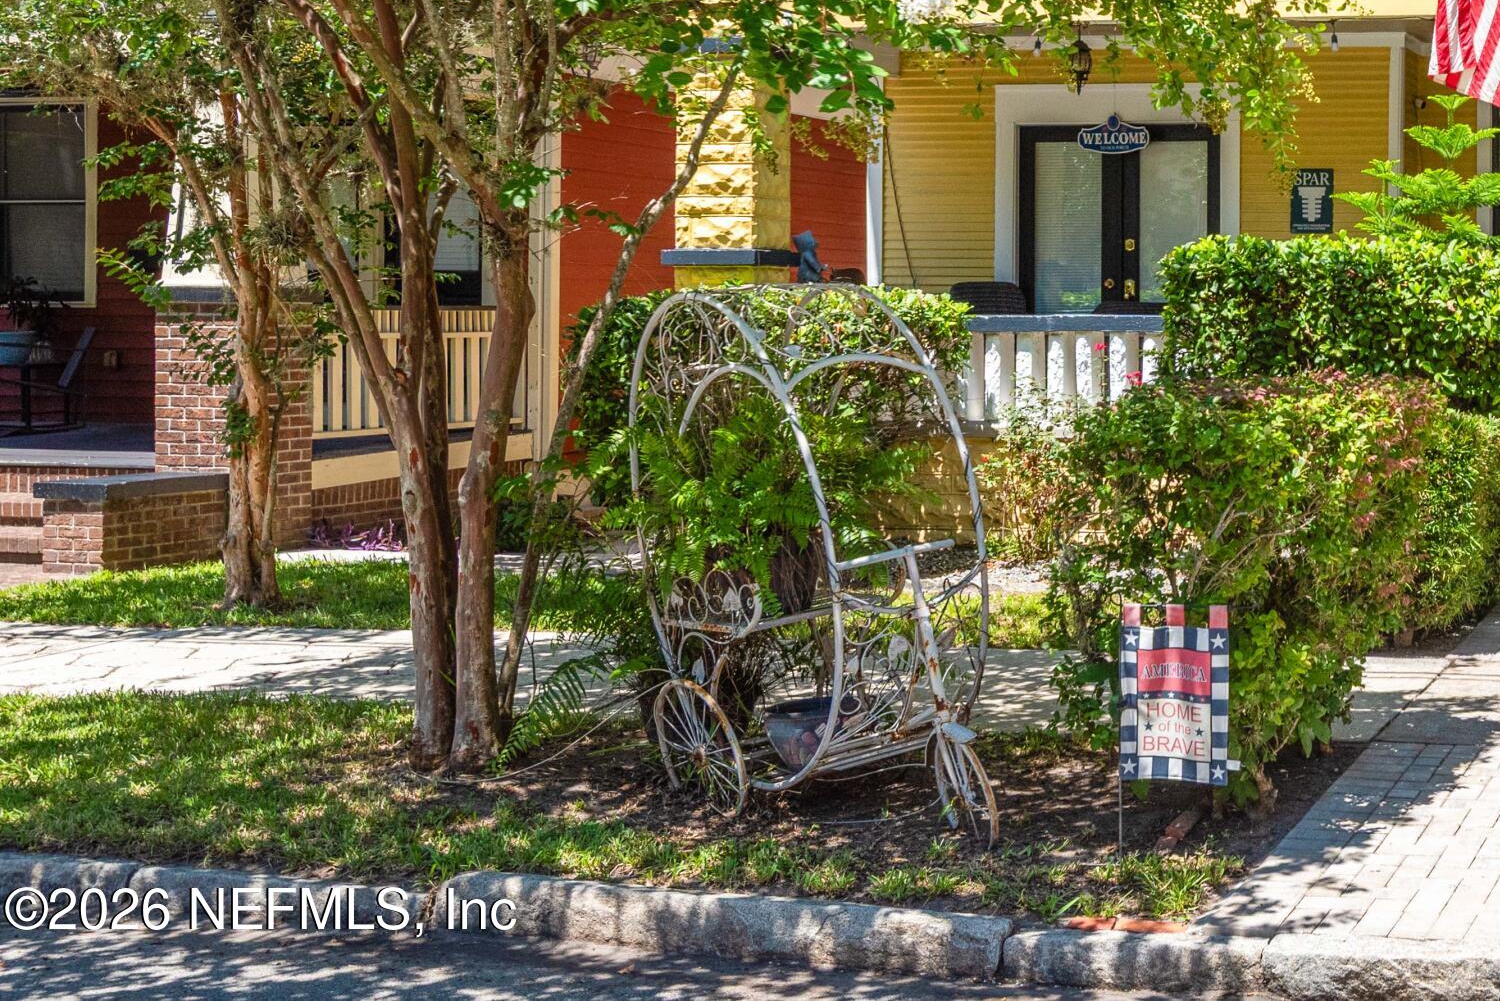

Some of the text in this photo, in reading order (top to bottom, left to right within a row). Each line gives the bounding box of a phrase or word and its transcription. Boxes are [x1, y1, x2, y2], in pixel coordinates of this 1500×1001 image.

[1082, 131, 1147, 145] WELCOME
[1294, 171, 1330, 186] SPAR
[1140, 662, 1207, 683] AMERICA
[1146, 702, 1202, 724] HOME
[1158, 721, 1191, 735] of the
[1142, 735, 1206, 757] BRAVE
